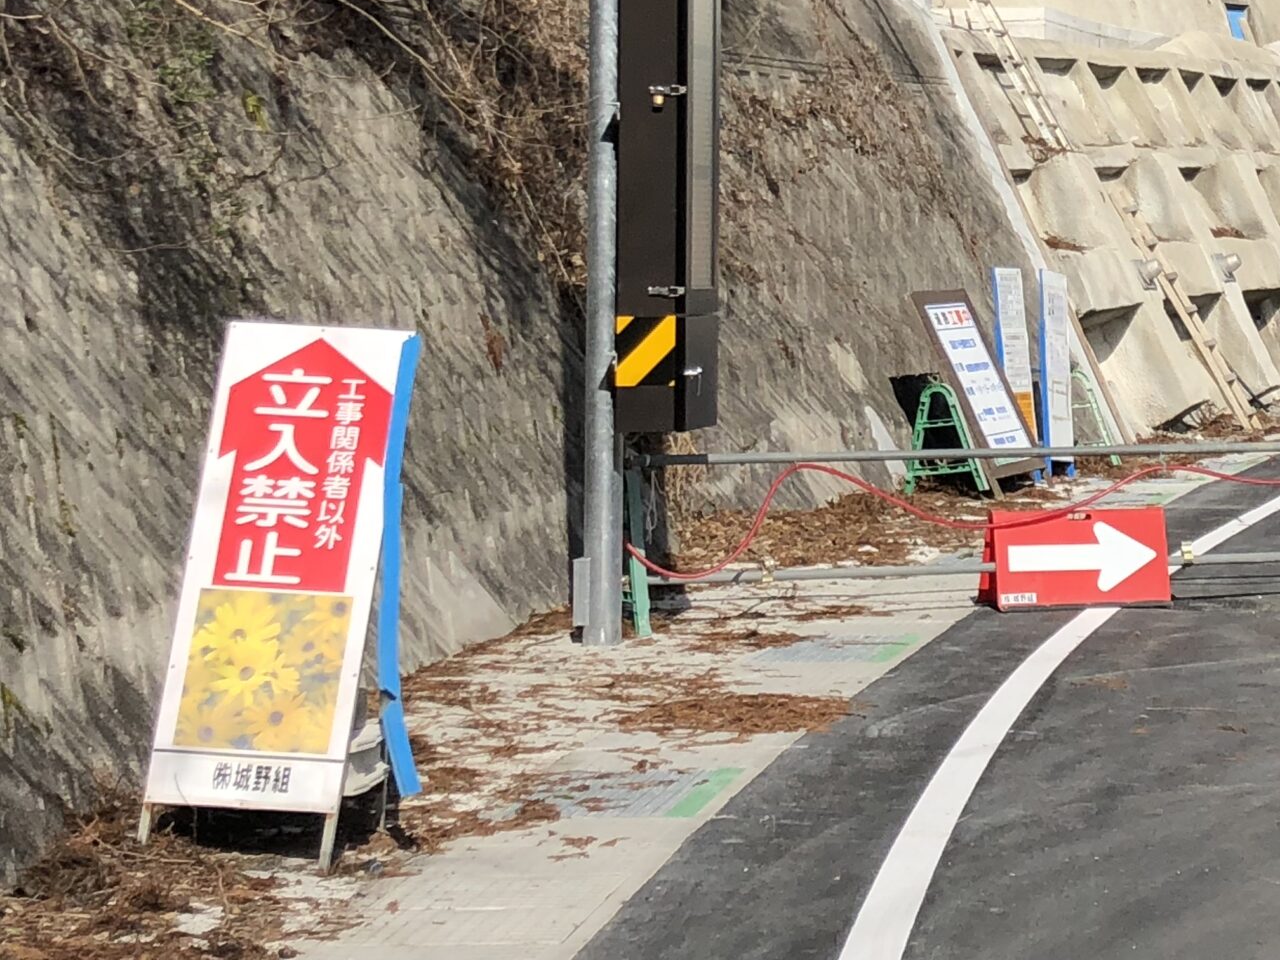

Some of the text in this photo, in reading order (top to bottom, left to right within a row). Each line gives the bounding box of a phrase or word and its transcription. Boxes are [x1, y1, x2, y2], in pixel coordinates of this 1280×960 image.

[223, 368, 333, 584] 立入禁止
[313, 379, 366, 550] 工事関係者以外
